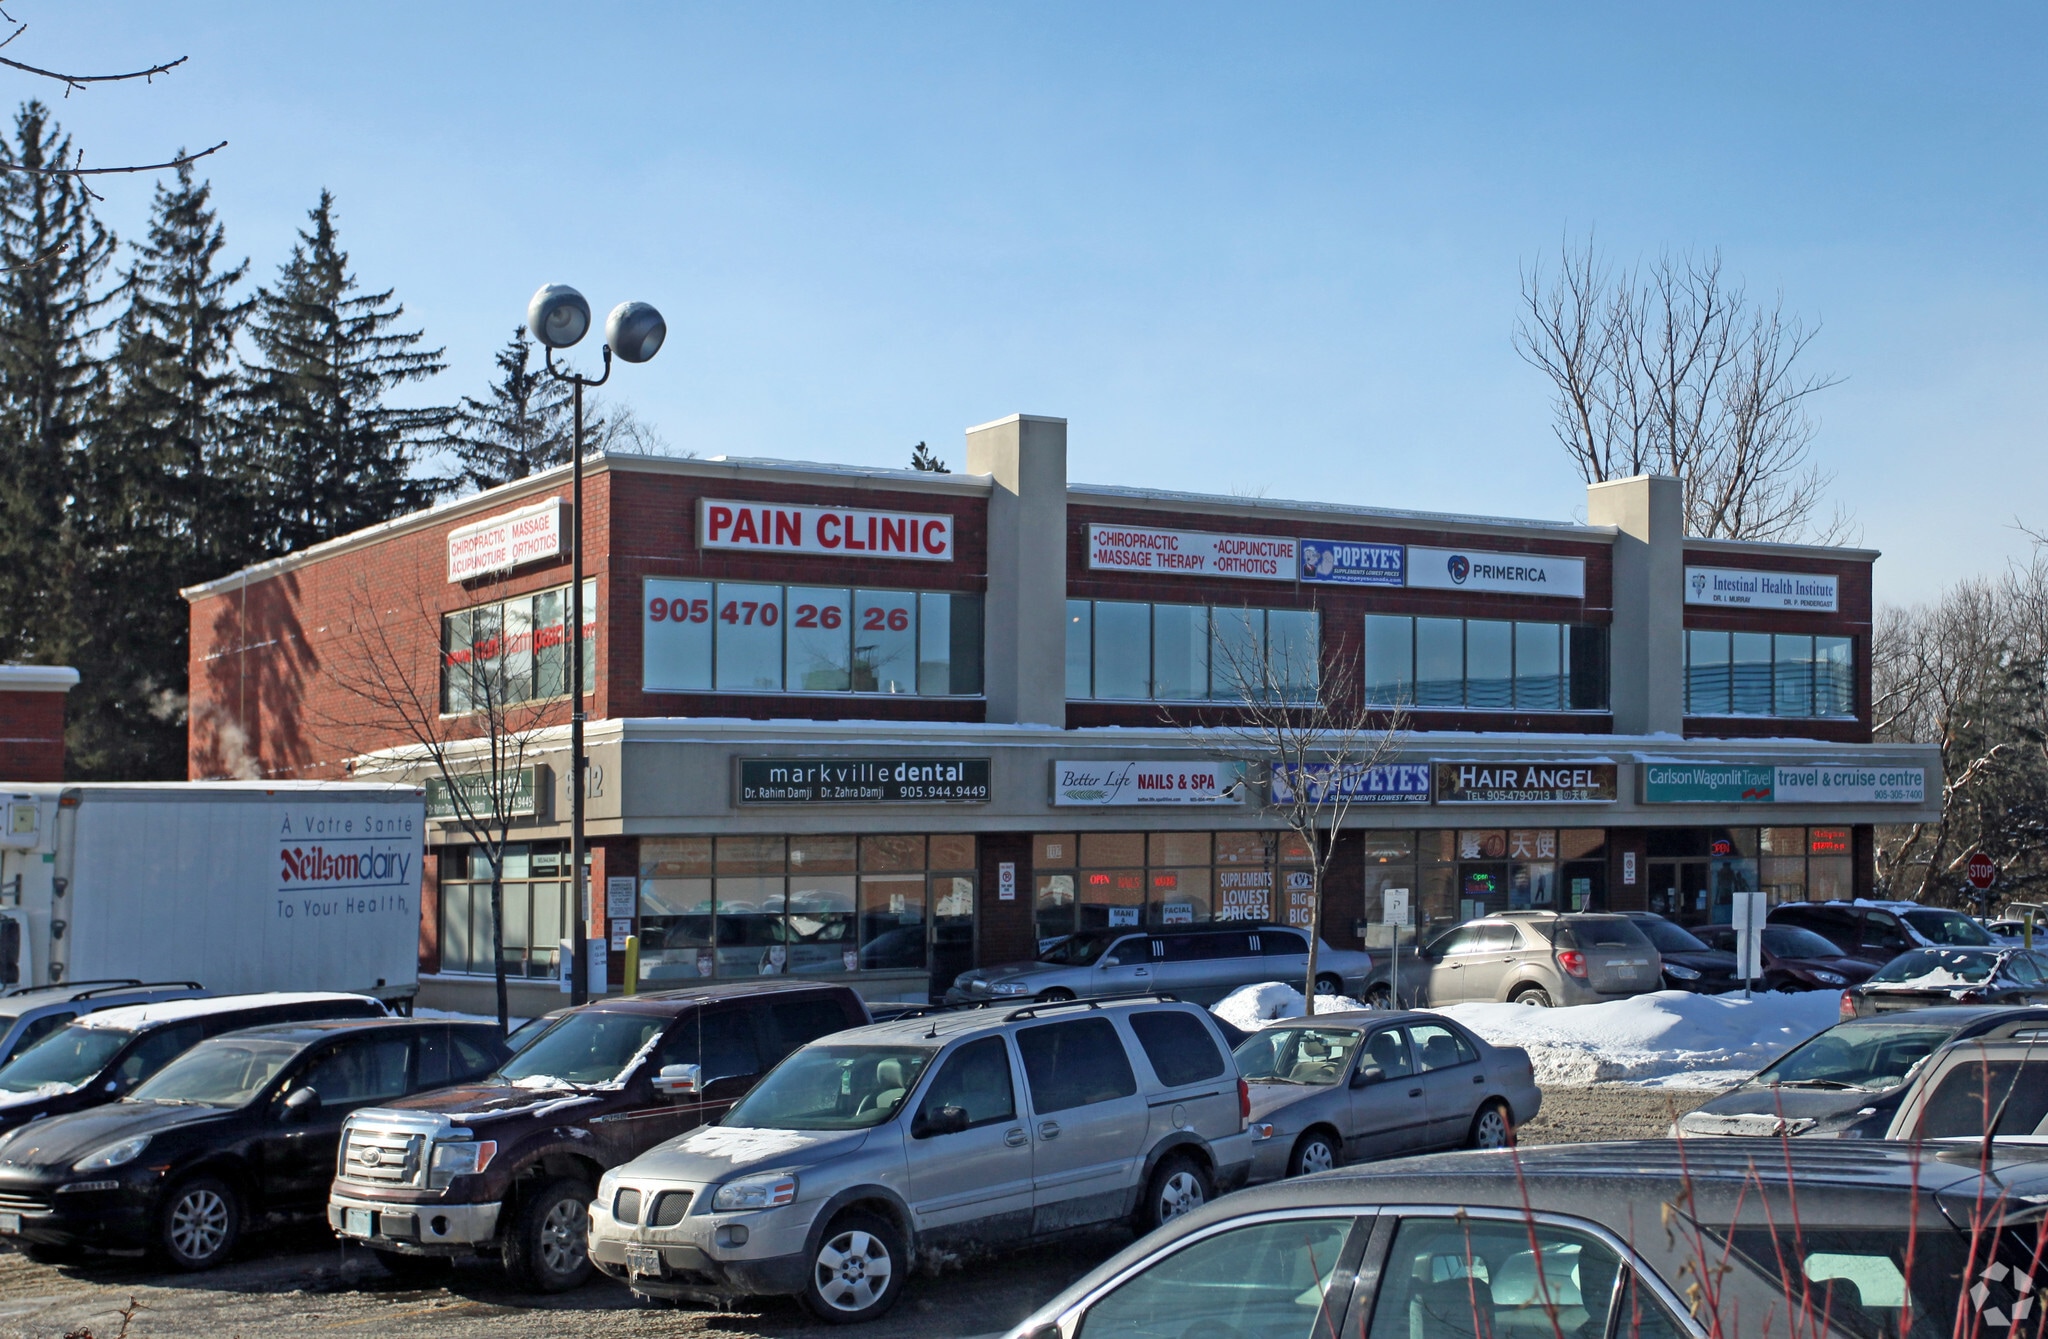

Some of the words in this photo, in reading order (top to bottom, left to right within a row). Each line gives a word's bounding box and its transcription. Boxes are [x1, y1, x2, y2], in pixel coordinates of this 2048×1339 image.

[451, 528, 506, 557] CHIROPRACTIC
[512, 515, 550, 538] MASSAGE
[708, 505, 802, 546] PAIN
[815, 513, 947, 555] CLINIC
[1098, 530, 1179, 551] CHIROPRACTIC
[1218, 539, 1294, 559] ACUPUNCTURE
[451, 548, 506, 575] ACUPUNCTURE
[512, 533, 557, 558] ORTHOTICS
[1098, 549, 1152, 567] MASSAGE
[1157, 553, 1205, 570] THERAPY
[1217, 556, 1278, 575] ORTHOTICS
[1333, 545, 1401, 570] POPEYE'S
[1333, 568, 1366, 576] SUPPLEMENTS
[1473, 564, 1547, 583] PRIMERICA
[1713, 574, 1758, 593] Intestinal
[1761, 578, 1793, 595] Health
[1795, 580, 1833, 597] Institute
[649, 597, 708, 624] 905
[720, 600, 778, 627] 470
[795, 605, 841, 629] 26
[863, 608, 908, 631] 26
[770, 764, 889, 783] markville
[894, 762, 964, 782] dental
[1328, 765, 1429, 792] POPEYE'S
[1459, 766, 1518, 788] HAIR
[1526, 767, 1600, 788] ANGEL
[1649, 768, 1692, 785] Carlson
[1694, 769, 1742, 789] Wagonlit
[1742, 769, 1772, 785] Travel
[1778, 769, 1818, 786] travel
[1823, 771, 1831, 786] &
[1834, 769, 1876, 786] cruise
[1880, 770, 1922, 786] centre
[1062, 771, 1100, 786] Better
[1102, 762, 1136, 804] Life
[1138, 774, 1173, 789] NAILS
[1178, 774, 1187, 789] &
[1191, 774, 1215, 789] SPA
[745, 787, 756, 798] Dr.
[759, 786, 785, 798] Rahim
[788, 787, 812, 800] Damji
[821, 786, 832, 797] Dr.
[835, 786, 858, 797] Zahra
[860, 786, 884, 798] Damji
[900, 785, 986, 797] 905.944.9449
[1486, 790, 1550, 800] 905-479-0713
[1874, 789, 1923, 800] 905-305-7400
[305, 816, 352, 833] Votre
[365, 815, 412, 832] Santé
[1220, 872, 1272, 887] SUPPLEMENTS
[1970, 865, 1993, 878] STOP
[1090, 874, 1110, 885] OPEN
[1118, 876, 1140, 889] NAILS
[1223, 890, 1269, 905] LOWEST
[1291, 893, 1306, 905] BIG
[277, 900, 294, 918] To
[304, 900, 338, 917] Your
[1164, 906, 1191, 914] FACIAL
[1222, 905, 1269, 920] PRICES
[1289, 908, 1308, 923] BIG
